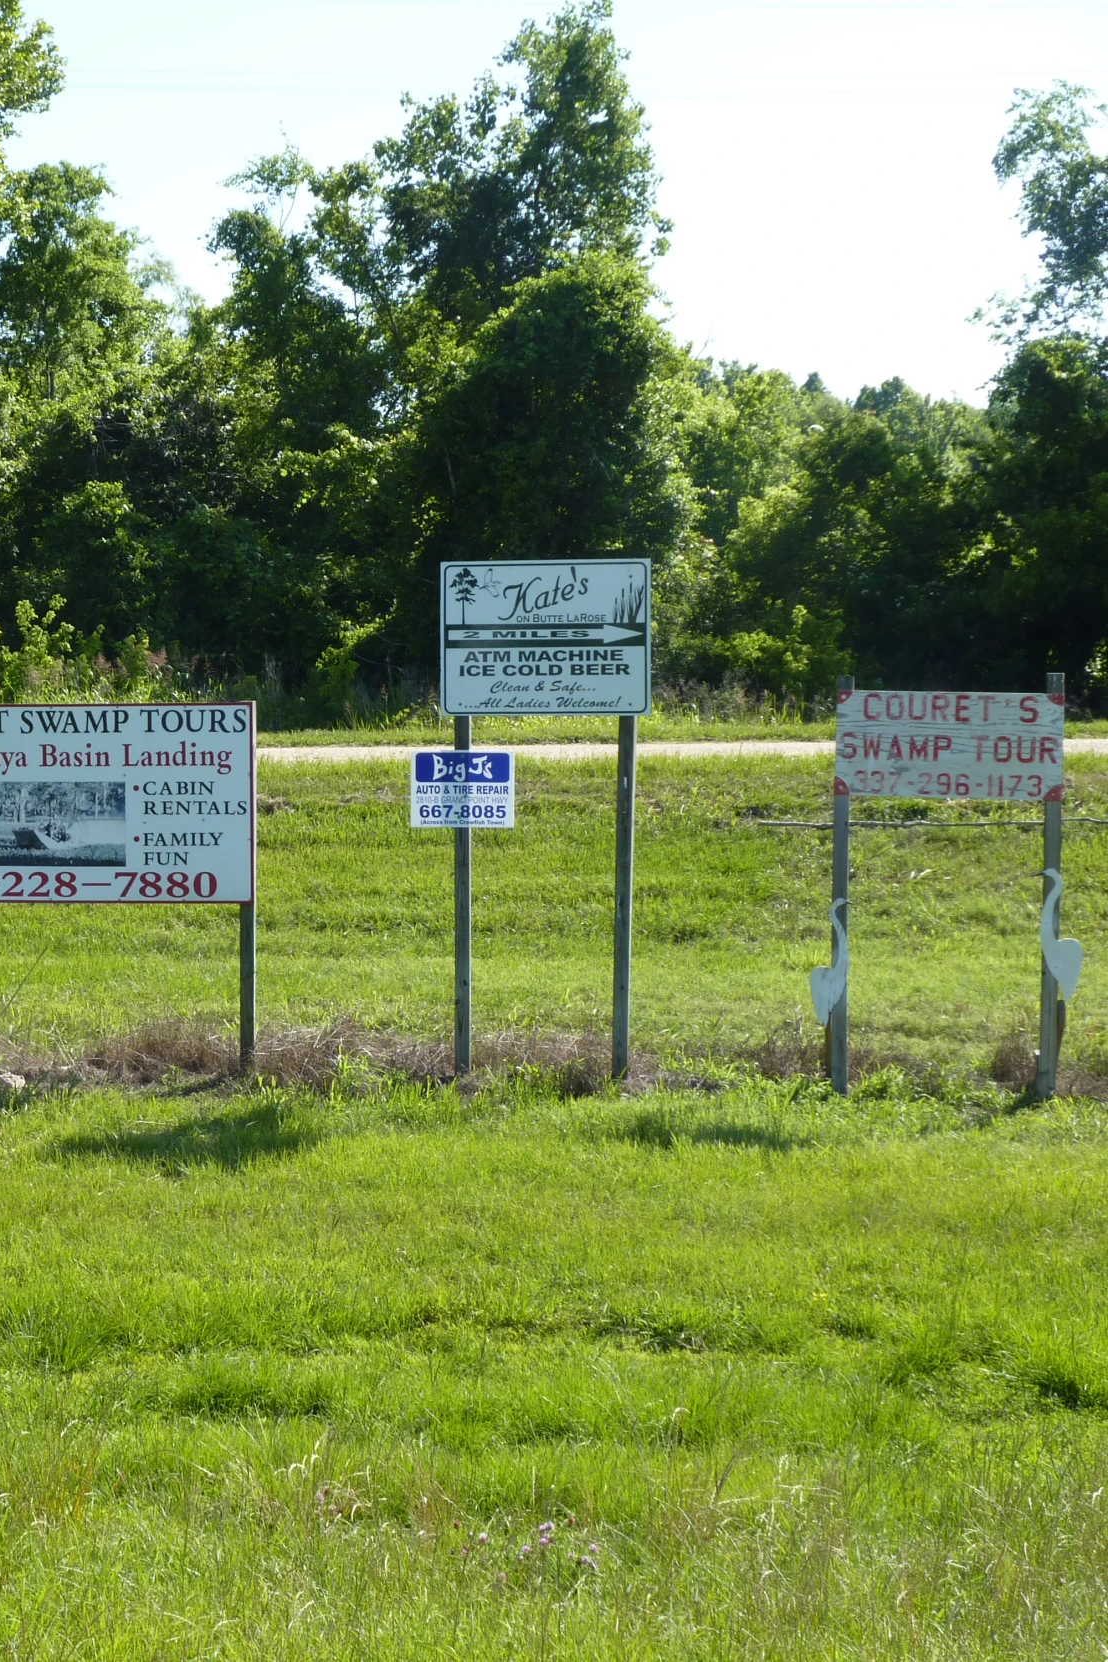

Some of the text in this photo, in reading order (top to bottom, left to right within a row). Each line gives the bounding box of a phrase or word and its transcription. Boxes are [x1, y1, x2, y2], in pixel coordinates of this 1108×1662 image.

[498, 566, 589, 621] Kate's
[463, 630, 590, 639] 2 MILES
[464, 650, 624, 663] ATM MACHINE
[459, 663, 631, 677] ICE COLD BEER
[490, 680, 596, 695] Clean & Safe...
[503, 697, 551, 709] Ladies
[556, 696, 621, 709] Welcome!
[20, 709, 129, 734] SWAMP
[140, 708, 247, 734] TOURS
[839, 732, 1058, 764] SWAMP TOUR
[39, 742, 111, 767] Basin
[122, 741, 232, 775] Landing
[432, 753, 466, 782] Big
[142, 781, 215, 796] CABIN
[416, 785, 509, 794] AUTO & TIRE REPAIR
[853, 769, 1043, 798] 337-296-1173
[441, 796, 467, 804] GRAND
[469, 796, 489, 804] POINT
[143, 801, 247, 816] RENTALS
[419, 804, 507, 819] 667-8085
[142, 832, 223, 847] FAMILY
[143, 852, 188, 866] FUN
